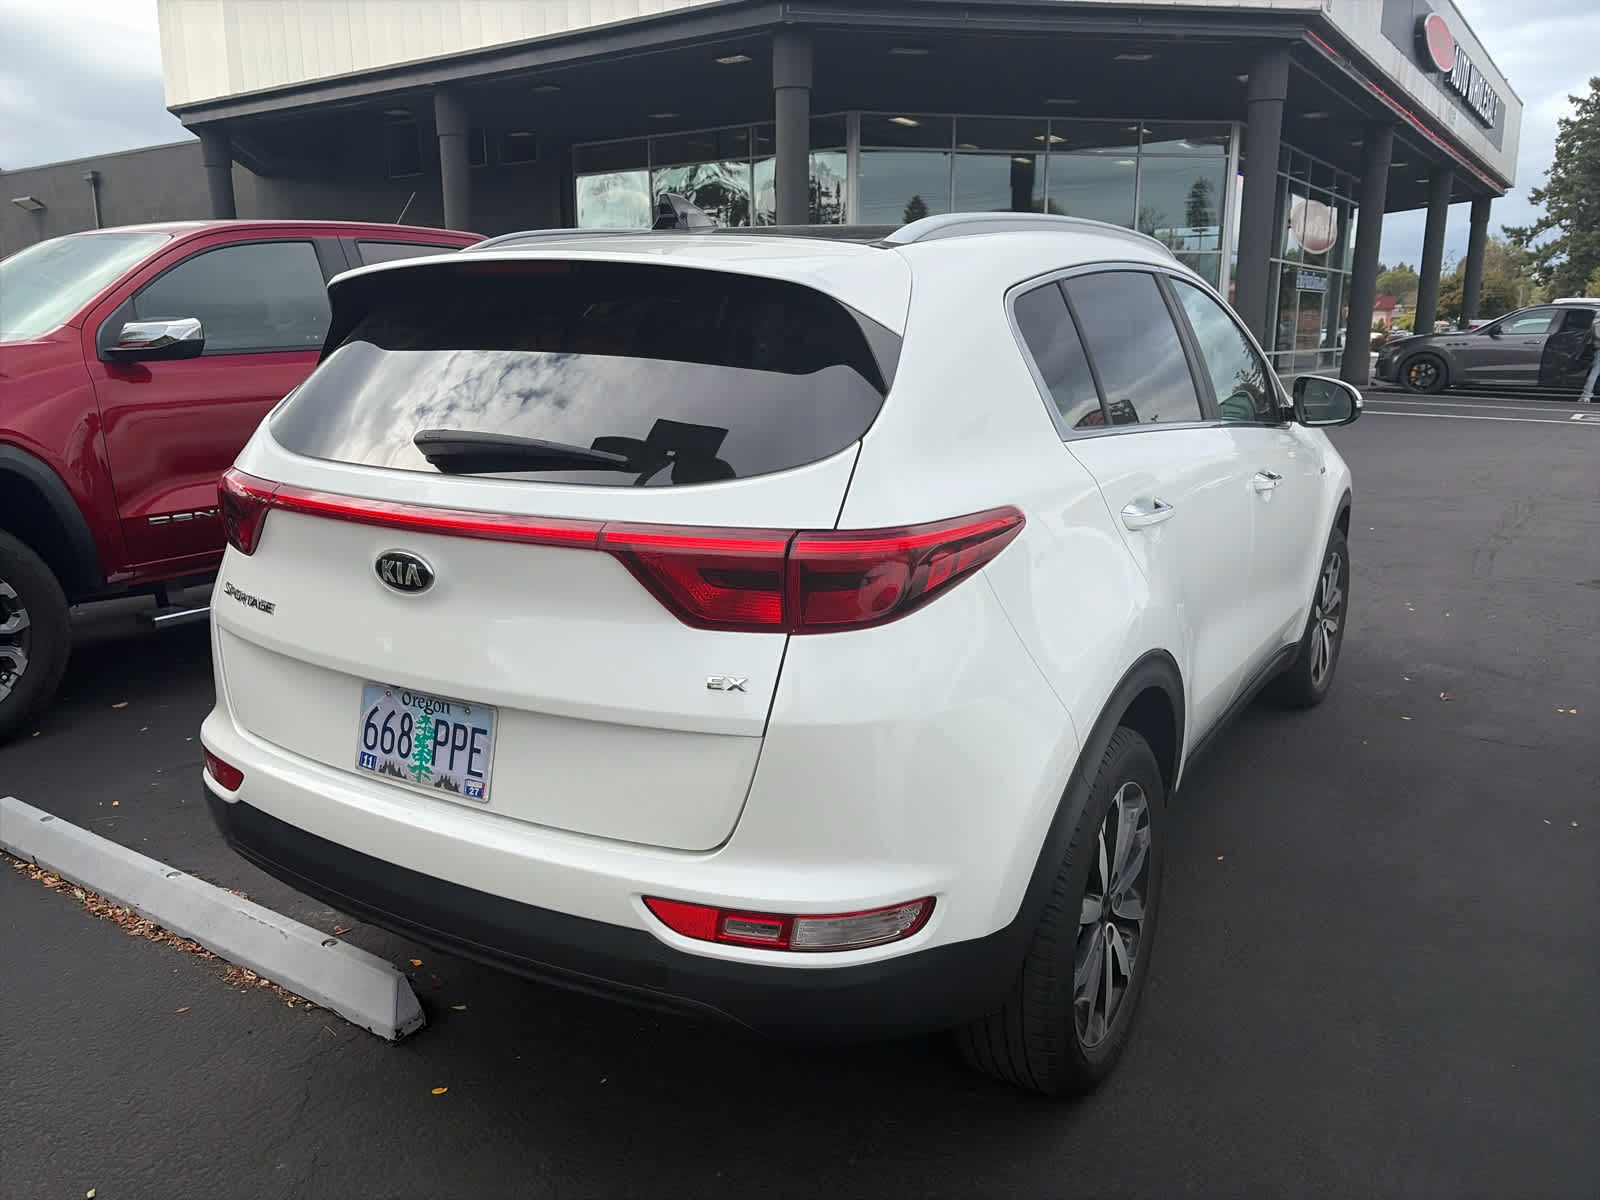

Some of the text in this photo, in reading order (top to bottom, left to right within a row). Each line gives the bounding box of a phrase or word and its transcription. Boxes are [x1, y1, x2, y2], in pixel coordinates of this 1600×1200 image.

[1450, 45, 1470, 97] AUTO
[382, 559, 422, 587] KIA
[224, 582, 275, 614] SPORTAGE
[706, 676, 748, 692] EX
[401, 691, 450, 715] Oregon
[363, 706, 487, 778] 668 PPE
[362, 753, 374, 768] 11
[468, 787, 480, 797] 27
